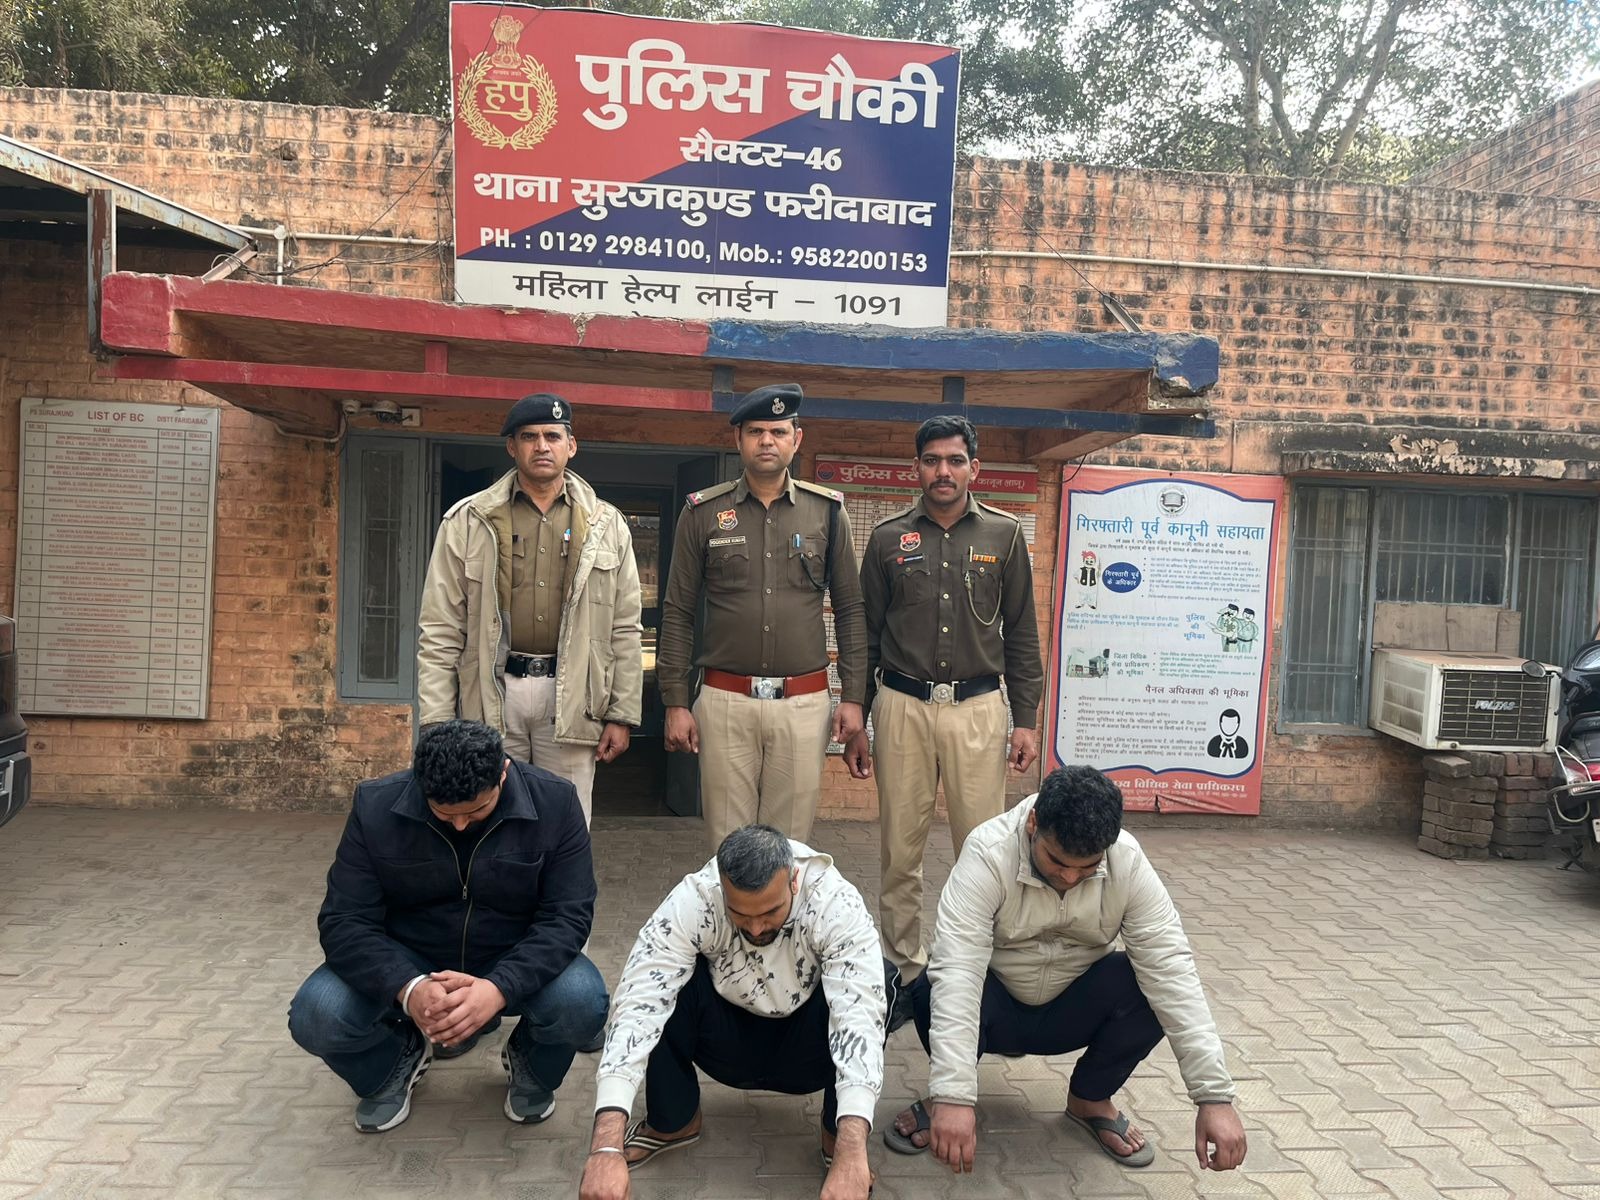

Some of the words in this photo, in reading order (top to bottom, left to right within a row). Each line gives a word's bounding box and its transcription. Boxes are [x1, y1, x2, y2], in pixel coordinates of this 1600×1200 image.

[575, 38, 771, 130] पुलिस
[785, 53, 945, 128] चौकी
[473, 172, 562, 203] थाना
[571, 178, 756, 225] सुरजकुण्ड
[764, 183, 937, 227] फरीदाबाद
[479, 227, 517, 249] PH.
[539, 230, 598, 252] 0129
[604, 235, 712, 265] 2984100,
[719, 242, 783, 264] Mob.:
[790, 246, 928, 273] 9582200153
[512, 270, 609, 300] महिला
[621, 273, 681, 304] हेल्प
[695, 280, 779, 310] लाईन
[833, 292, 902, 316] 1091
[87, 410, 110, 420] LIST
[112, 412, 127, 421] OF
[130, 413, 144, 422] BC
[174, 417, 208, 425] FARIDABAD
[839, 464, 892, 482] पुलिस
[1076, 514, 1133, 533] गिरफ्तारी
[1141, 517, 1160, 540] पूर्व
[1168, 520, 1209, 541] कानूनी
[1216, 524, 1265, 540] सहायता
[1146, 684, 1164, 694] पैनल
[1168, 685, 1204, 696] अधिवक्ता
[1208, 687, 1219, 697] की
[1223, 688, 1249, 699] भूमिका
[1474, 699, 1516, 711] VOLTAS
[1172, 779, 1193, 790] सेवा
